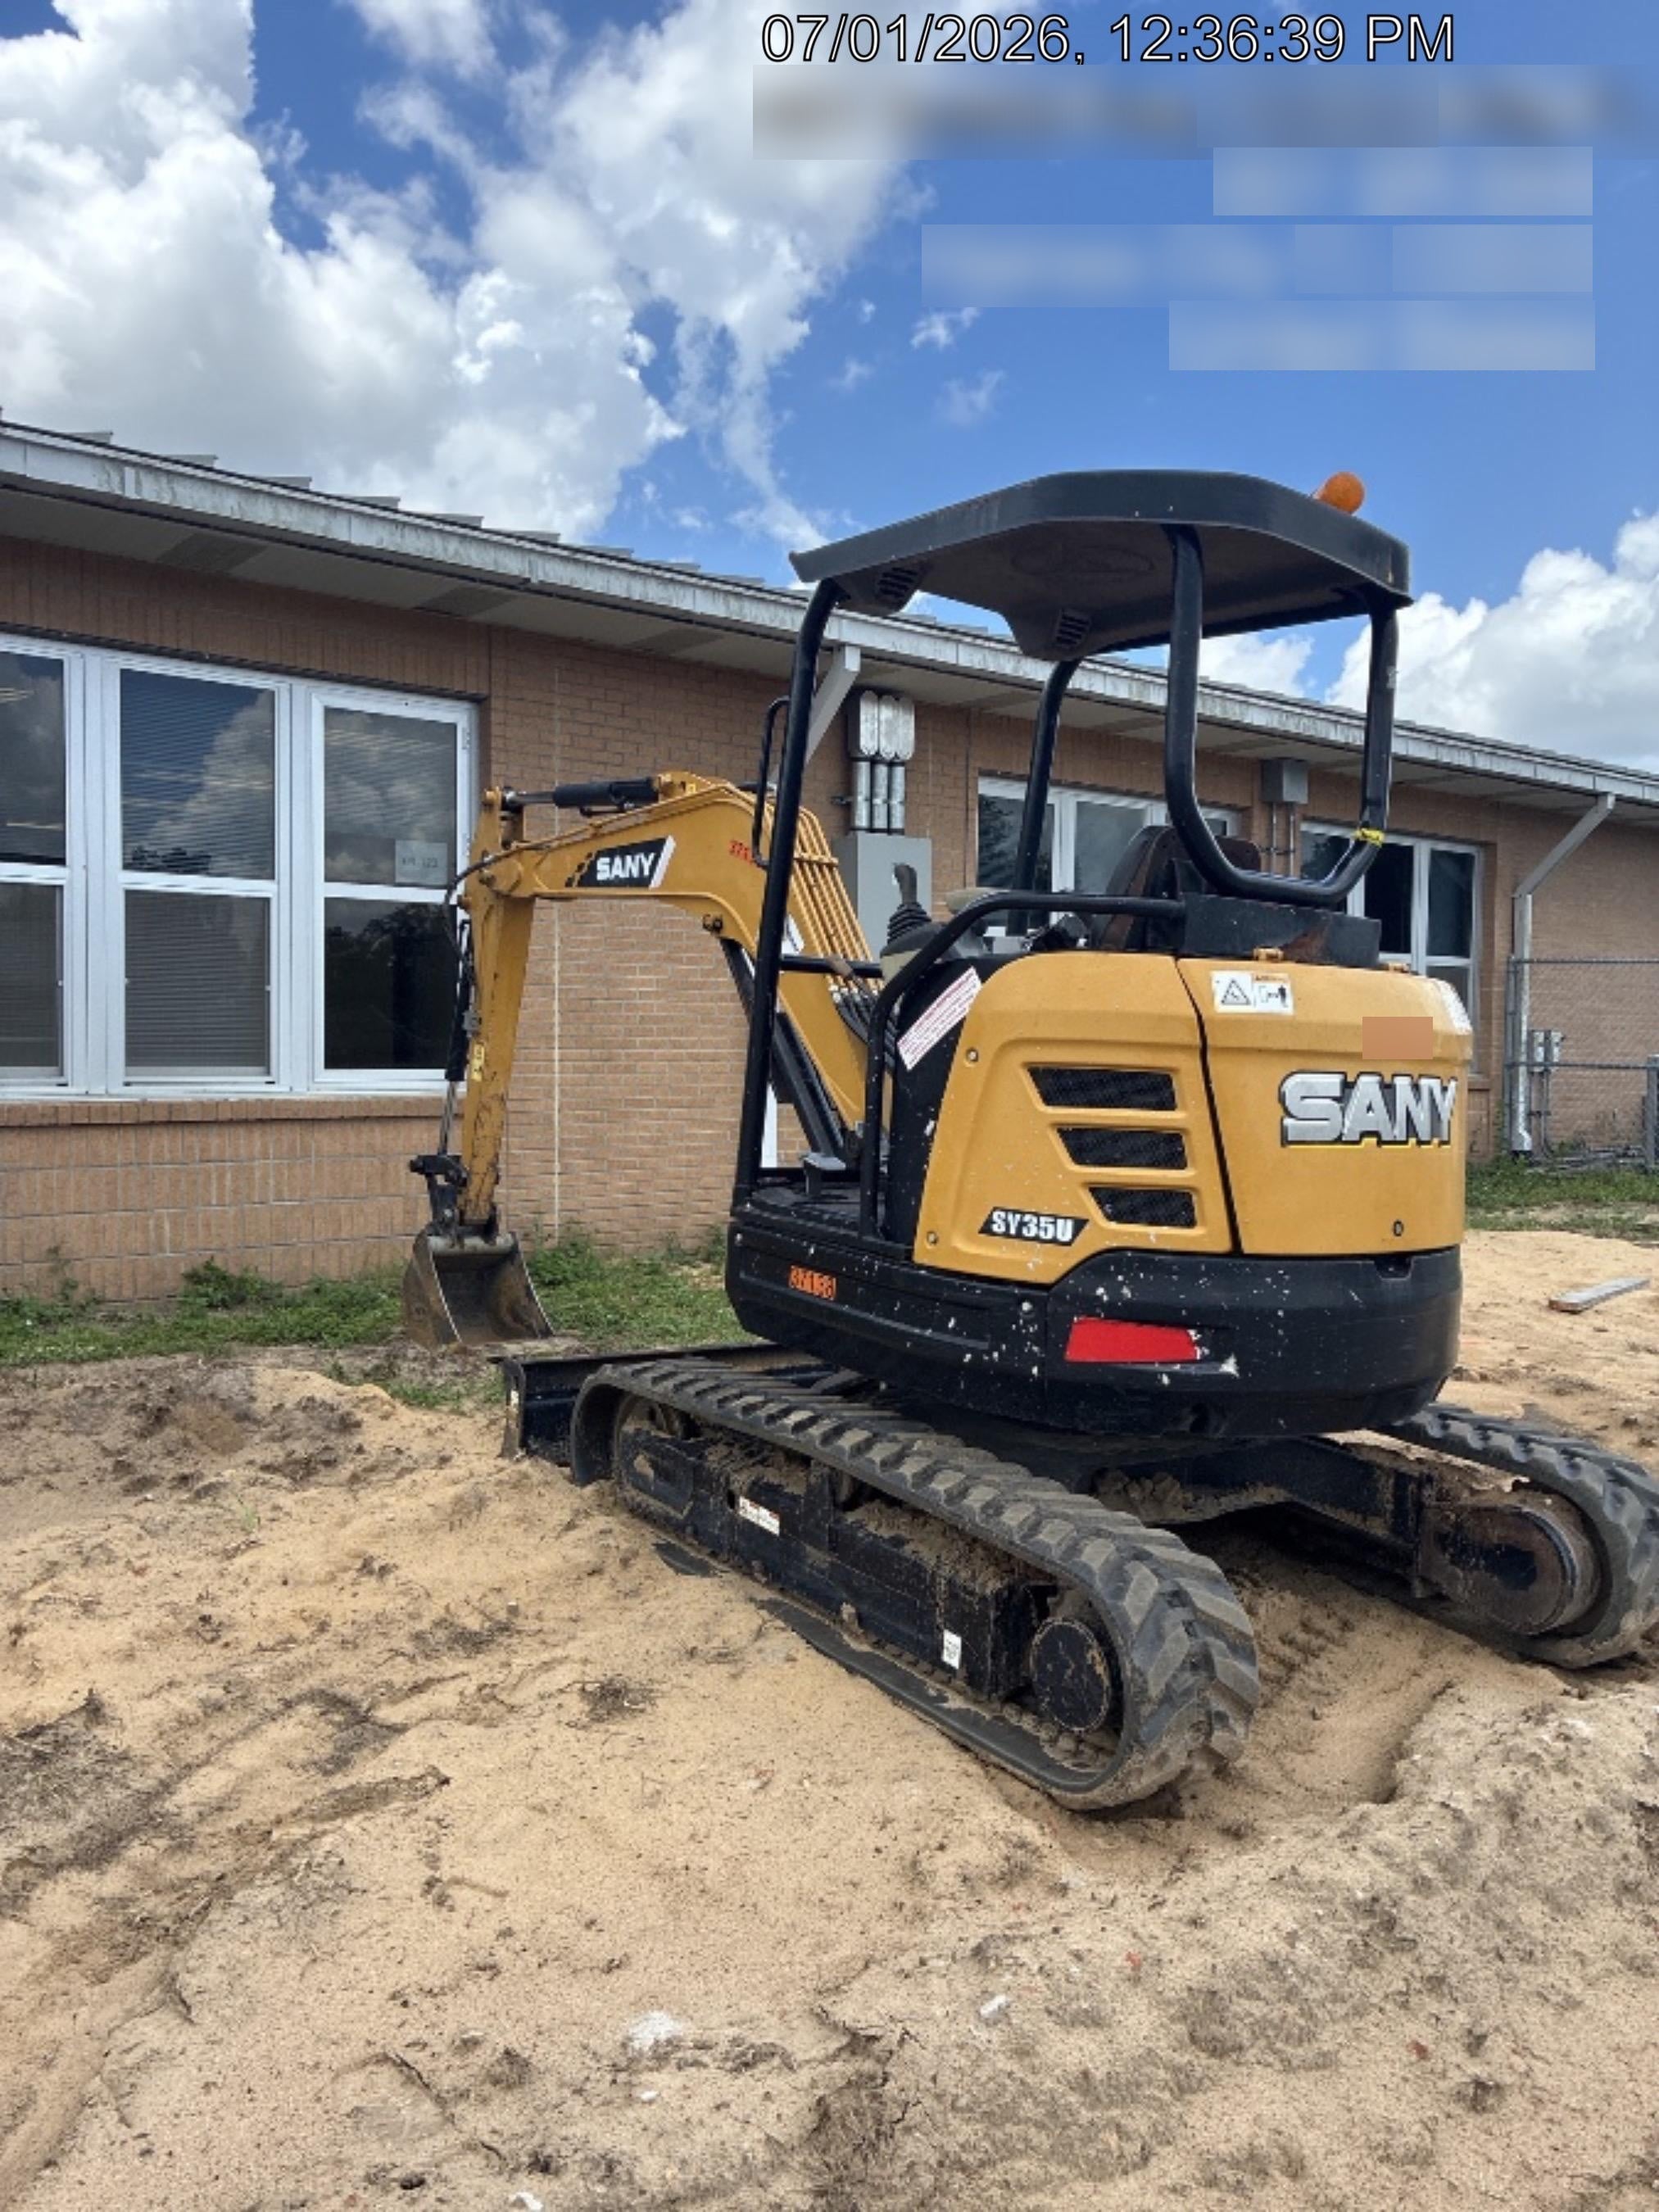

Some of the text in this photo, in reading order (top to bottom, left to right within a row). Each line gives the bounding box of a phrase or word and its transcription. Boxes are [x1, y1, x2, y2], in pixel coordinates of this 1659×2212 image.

[596, 852, 655, 881] SANY
[1279, 1070, 1458, 1146] SANY
[991, 1210, 1075, 1242] SY35U
